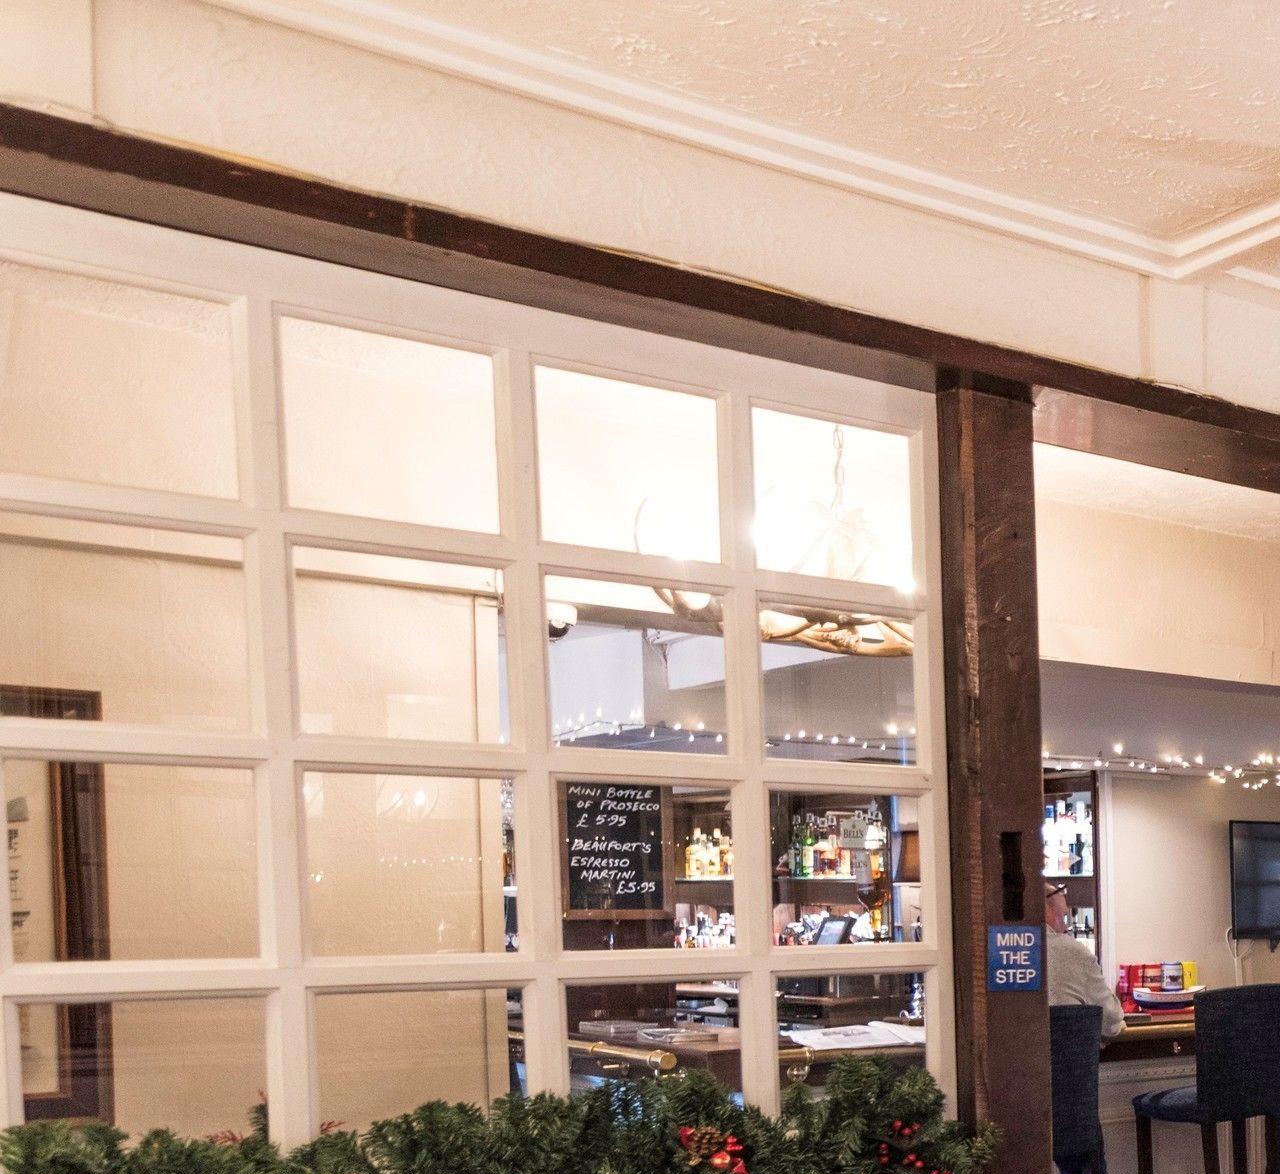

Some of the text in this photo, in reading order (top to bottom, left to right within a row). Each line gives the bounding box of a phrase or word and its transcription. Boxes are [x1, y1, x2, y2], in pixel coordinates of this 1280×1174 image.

[568, 785, 654, 800] MINI BOTTLE
[576, 800, 660, 812] OF PROSECCO
[571, 839, 652, 854] BEAUFORT'S
[570, 856, 630, 868] ESPRESSO
[580, 869, 636, 882] MARTINI
[616, 880, 656, 895] £5.95
[996, 932, 1035, 947] MIND
[999, 950, 1031, 965] THE
[995, 968, 1036, 984] STEP
